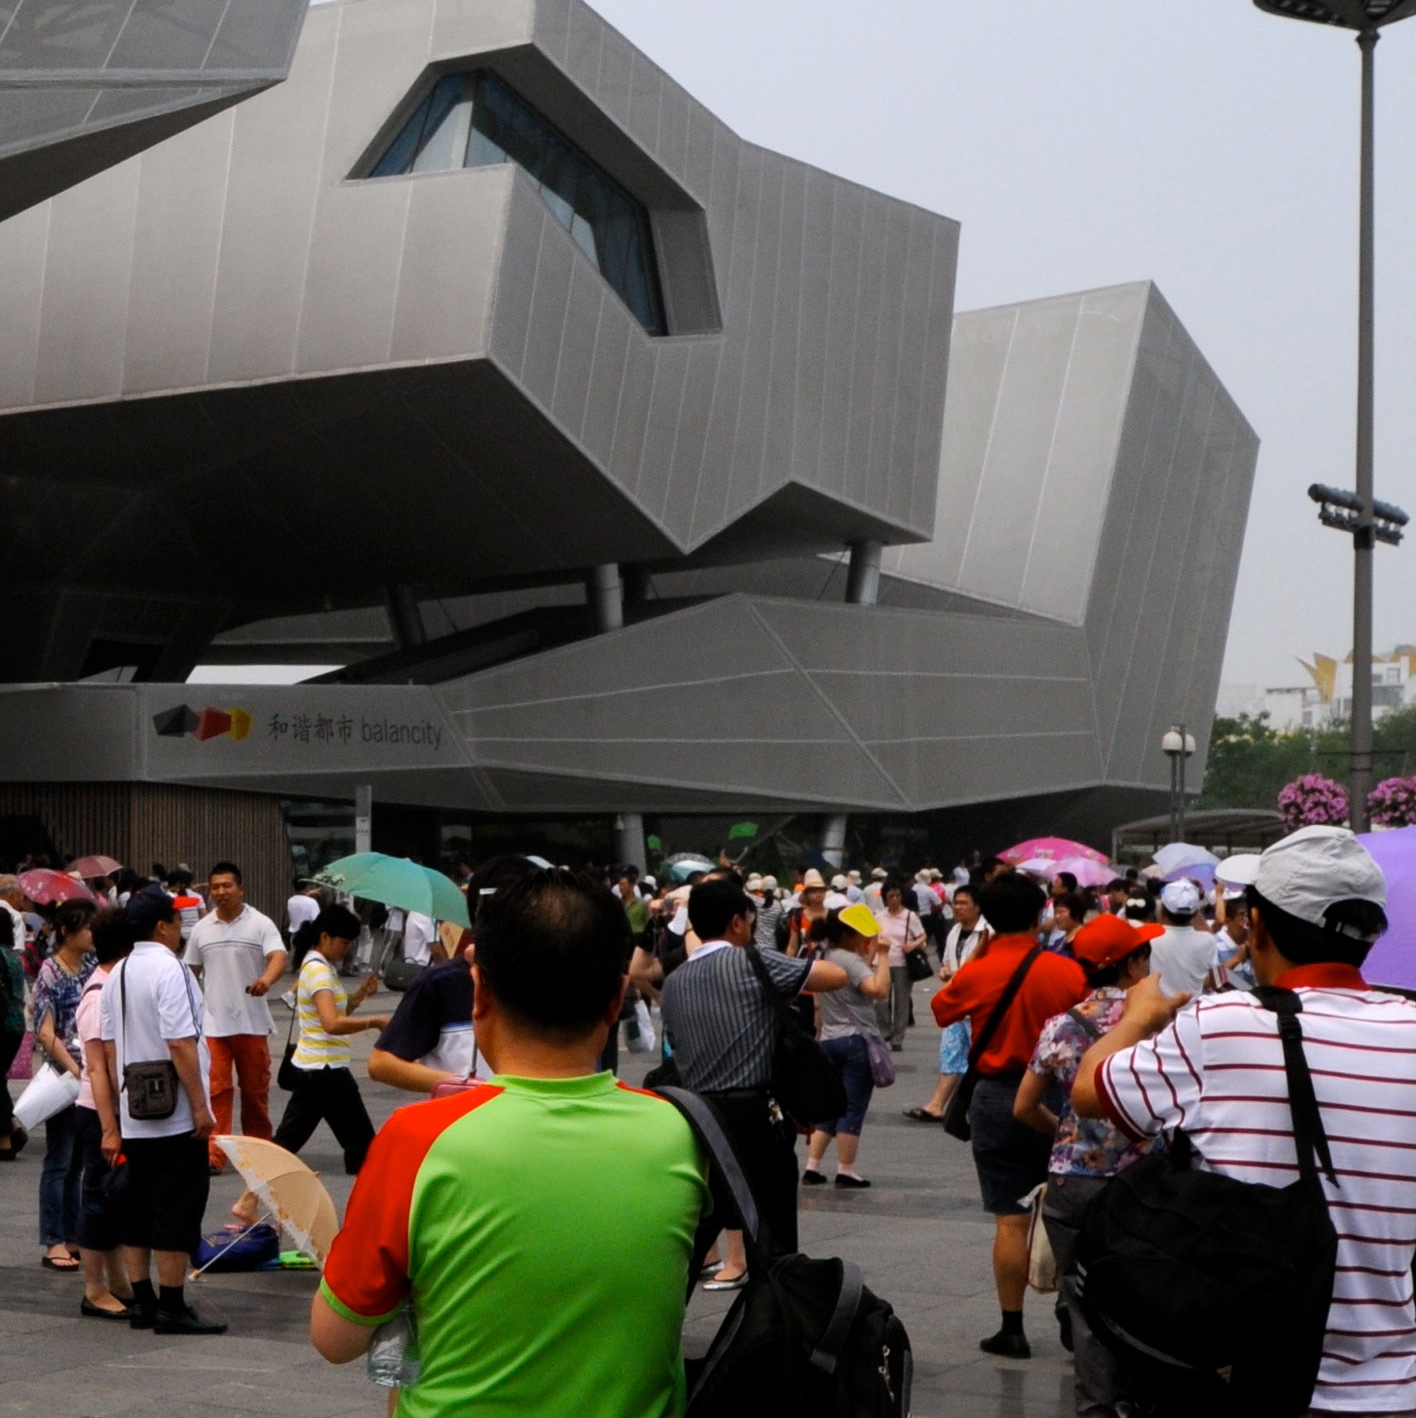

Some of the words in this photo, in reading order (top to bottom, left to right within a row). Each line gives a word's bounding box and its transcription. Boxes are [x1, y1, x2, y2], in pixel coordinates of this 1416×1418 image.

[268, 713, 353, 744] 和谐都市
[361, 717, 442, 750] balancity
